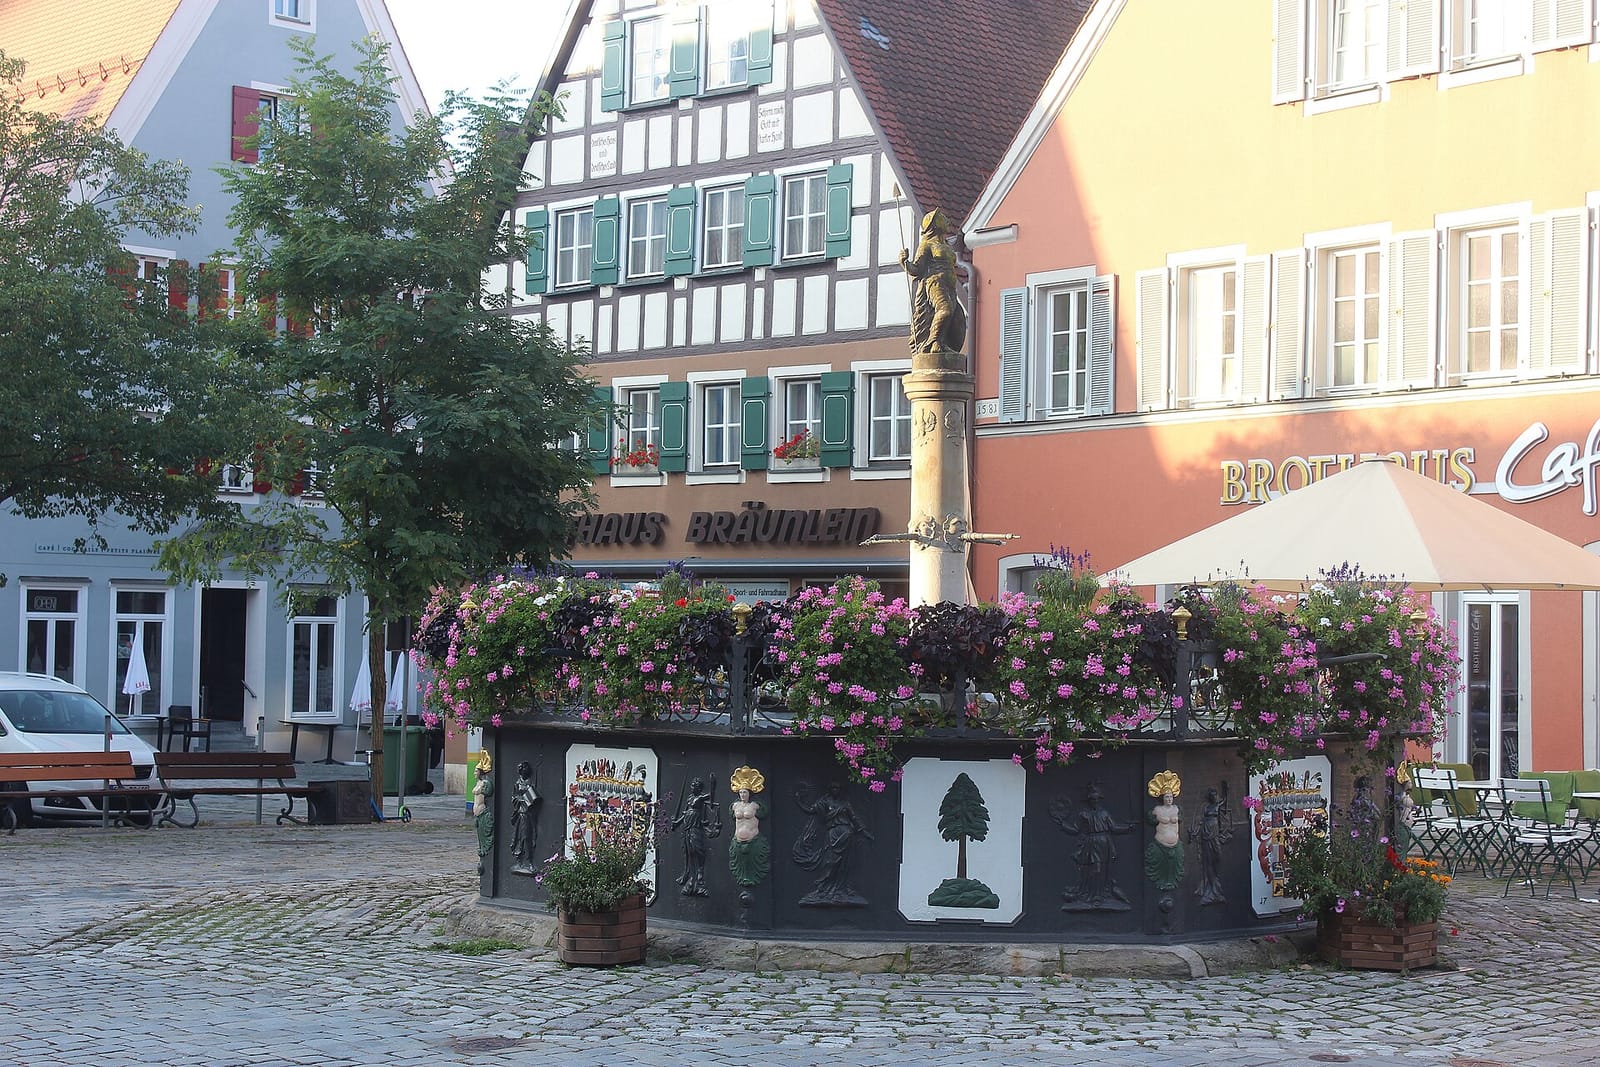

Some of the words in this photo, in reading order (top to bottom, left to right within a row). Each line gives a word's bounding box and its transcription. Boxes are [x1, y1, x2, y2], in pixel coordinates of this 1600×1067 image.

[1220, 448, 1475, 505] BROTUS
[569, 511, 668, 545] HAUS
[685, 500, 881, 544] BRÄUNLEIN
[733, 588, 748, 597] Sport-
[759, 588, 787, 596] Fahrradhaus
